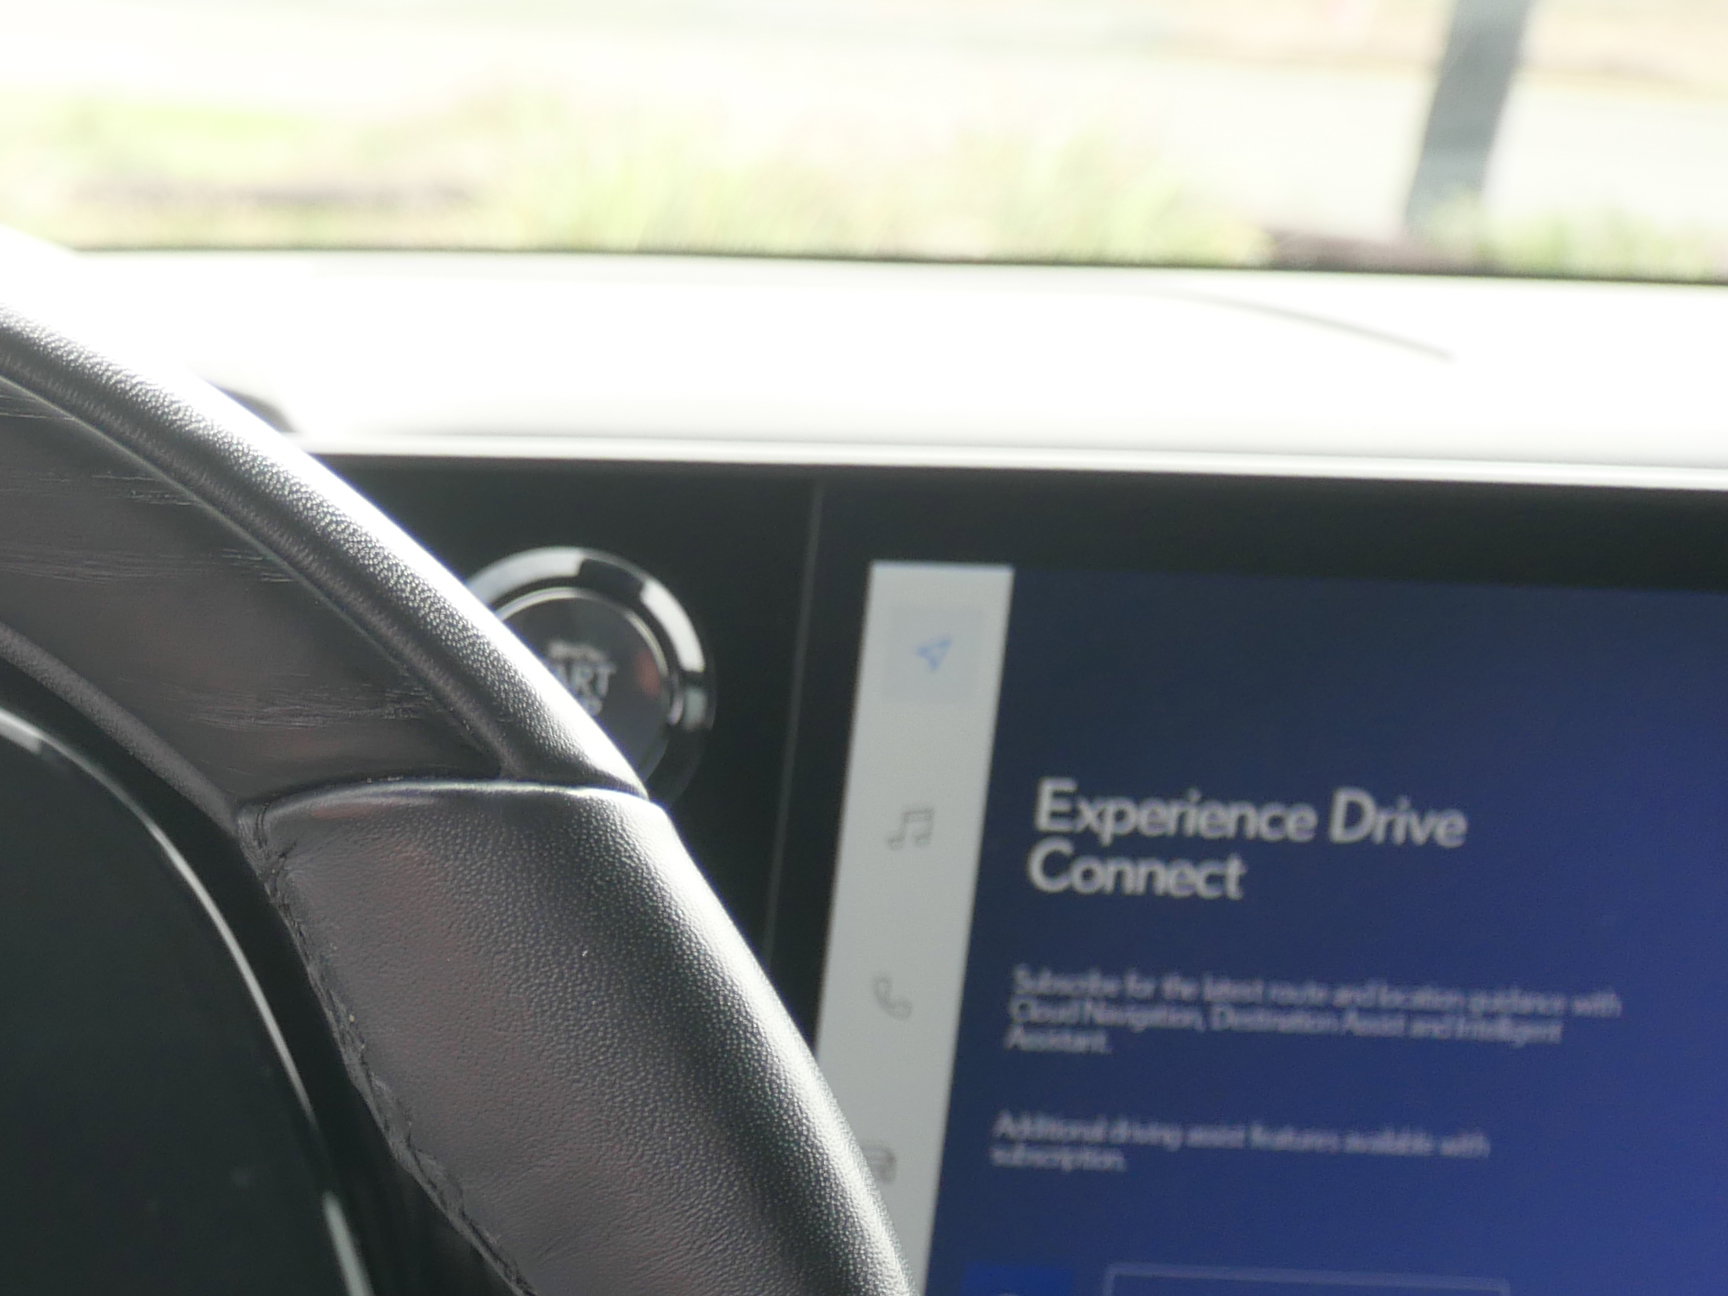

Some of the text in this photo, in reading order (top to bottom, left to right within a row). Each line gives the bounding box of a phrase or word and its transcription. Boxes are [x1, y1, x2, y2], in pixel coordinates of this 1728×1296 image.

[1033, 776, 1468, 848] Experience Drive
[1027, 835, 1246, 901] Connect
